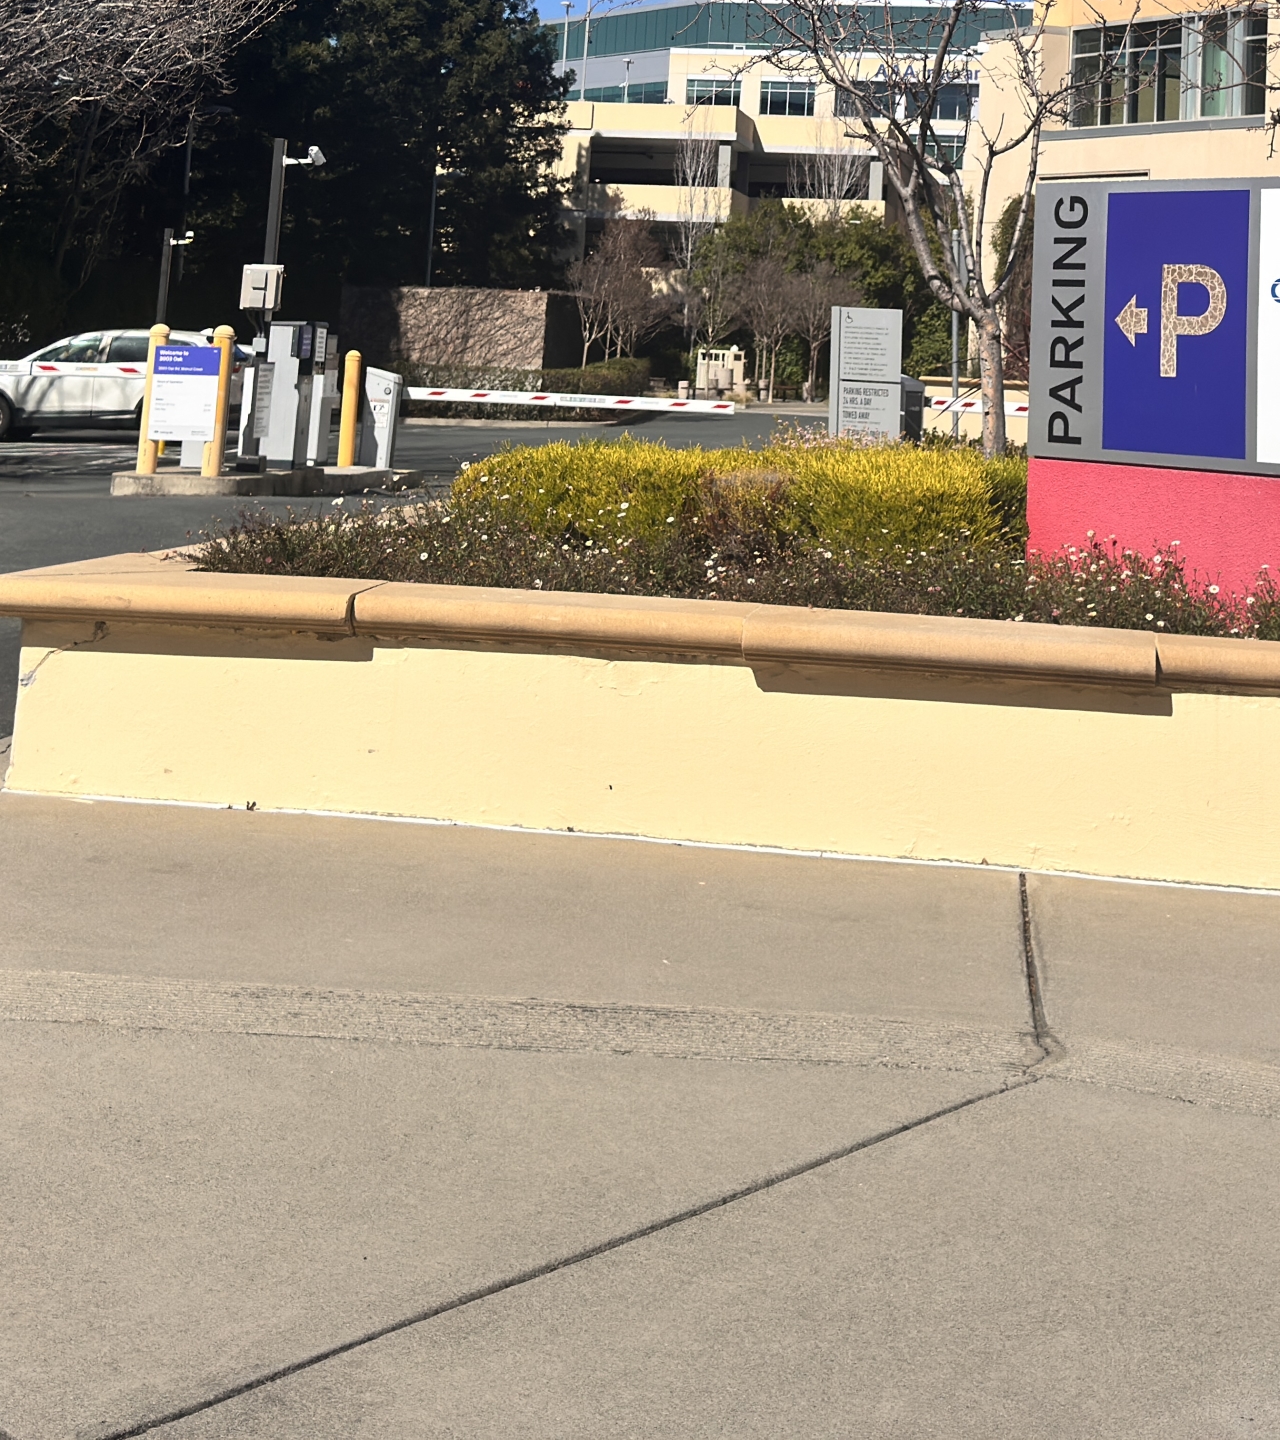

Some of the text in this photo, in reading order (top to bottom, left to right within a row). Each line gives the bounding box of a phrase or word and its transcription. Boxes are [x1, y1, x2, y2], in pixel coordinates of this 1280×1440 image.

[1047, 195, 1089, 445] PARKING
[1160, 264, 1227, 377] P
[843, 387, 889, 397] PARKING RESTRICTED
[863, 398, 872, 406] DAY
[842, 410, 870, 419] TOWED AWAY
